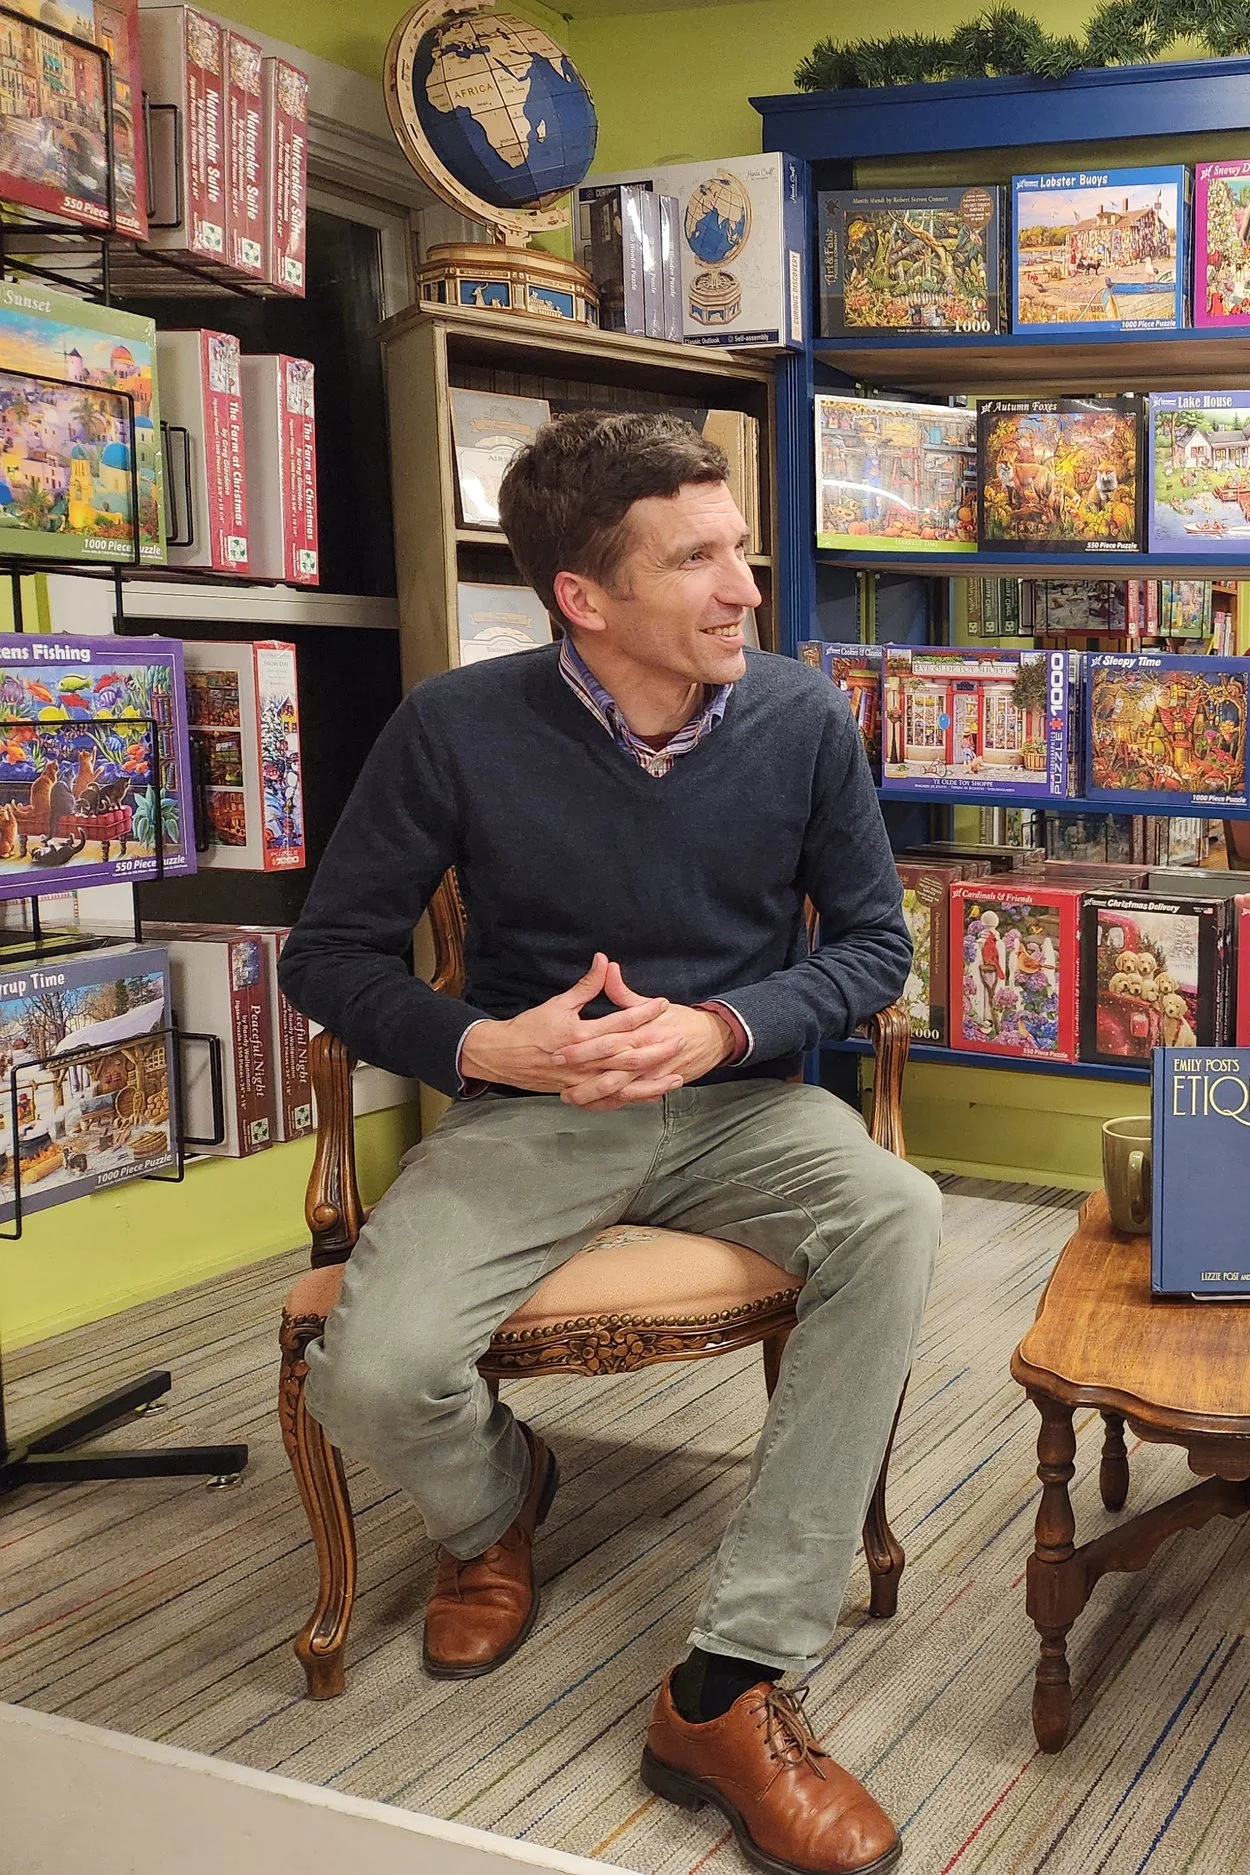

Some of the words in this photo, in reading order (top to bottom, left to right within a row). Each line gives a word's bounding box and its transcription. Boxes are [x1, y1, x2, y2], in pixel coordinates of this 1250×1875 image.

[454, 83, 494, 100] AFRICA
[206, 89, 221, 162] Nutcracker
[246, 110, 259, 183] Nutcracker
[291, 134, 303, 201] Nutcracker
[1213, 164, 1240, 176] Snowy
[207, 166, 220, 203] Suite
[1040, 175, 1076, 188] Lobster
[1079, 174, 1108, 187] Buoys
[247, 185, 259, 220] Suite
[63, 196, 83, 211] 550
[84, 202, 108, 217] Piece
[116, 214, 141, 229] uzzle
[791, 254, 799, 294] DISCOVERY
[4, 288, 51, 314] Sunset
[953, 319, 990, 333] 1000
[1122, 321, 1136, 329] 1000
[1137, 320, 1153, 328] Piece
[1155, 319, 1176, 328] Puzzle
[734, 334, 769, 343] Self-assembly
[993, 401, 1029, 413] Autumn
[1031, 401, 1057, 412] Foxes
[1177, 397, 1201, 408] Lake
[1203, 395, 1232, 408] House
[229, 402, 238, 421] The
[230, 424, 240, 453] Farm
[232, 456, 240, 467] at
[304, 444, 313, 471] Farm
[305, 474, 312, 485] at
[233, 471, 243, 526] Christmas
[305, 488, 314, 540] Christmas
[83, 538, 108, 550] 1000
[108, 540, 131, 552] Piece
[1116, 542, 1137, 550] Puzzle
[32, 644, 91, 661] Fishing
[1102, 656, 1136, 668] Sleepy
[1138, 656, 1161, 667] Time
[1050, 652, 1063, 716] 1000
[1055, 731, 1063, 795] PUZZLE
[1208, 795, 1225, 803] Piece
[1226, 796, 1247, 804] Puzzle
[115, 861, 133, 872] 550
[134, 860, 156, 871] Piece
[164, 855, 186, 866] uzzle
[962, 889, 996, 900] Cardinals
[997, 892, 1004, 901] &
[1006, 893, 1033, 903] Friends
[1107, 899, 1148, 911] Christmas
[1148, 902, 1181, 913] Delivery
[0, 979, 27, 998] rup
[30, 972, 65, 991] Time
[249, 1005, 263, 1058] Peaceful
[1034, 1049, 1049, 1057] Piece
[1050, 1051, 1068, 1059] Puzzle
[295, 1048, 308, 1084] Night
[1174, 1059, 1201, 1072] EMILY
[1205, 1059, 1240, 1072] POST'S
[251, 1061, 265, 1098] Night
[97, 1170, 119, 1184] 1000
[120, 1163, 143, 1177] Piece
[144, 1153, 173, 1172] Puzzle
[1201, 1271, 1221, 1281] LIZZIE
[1223, 1271, 1239, 1281] POST
